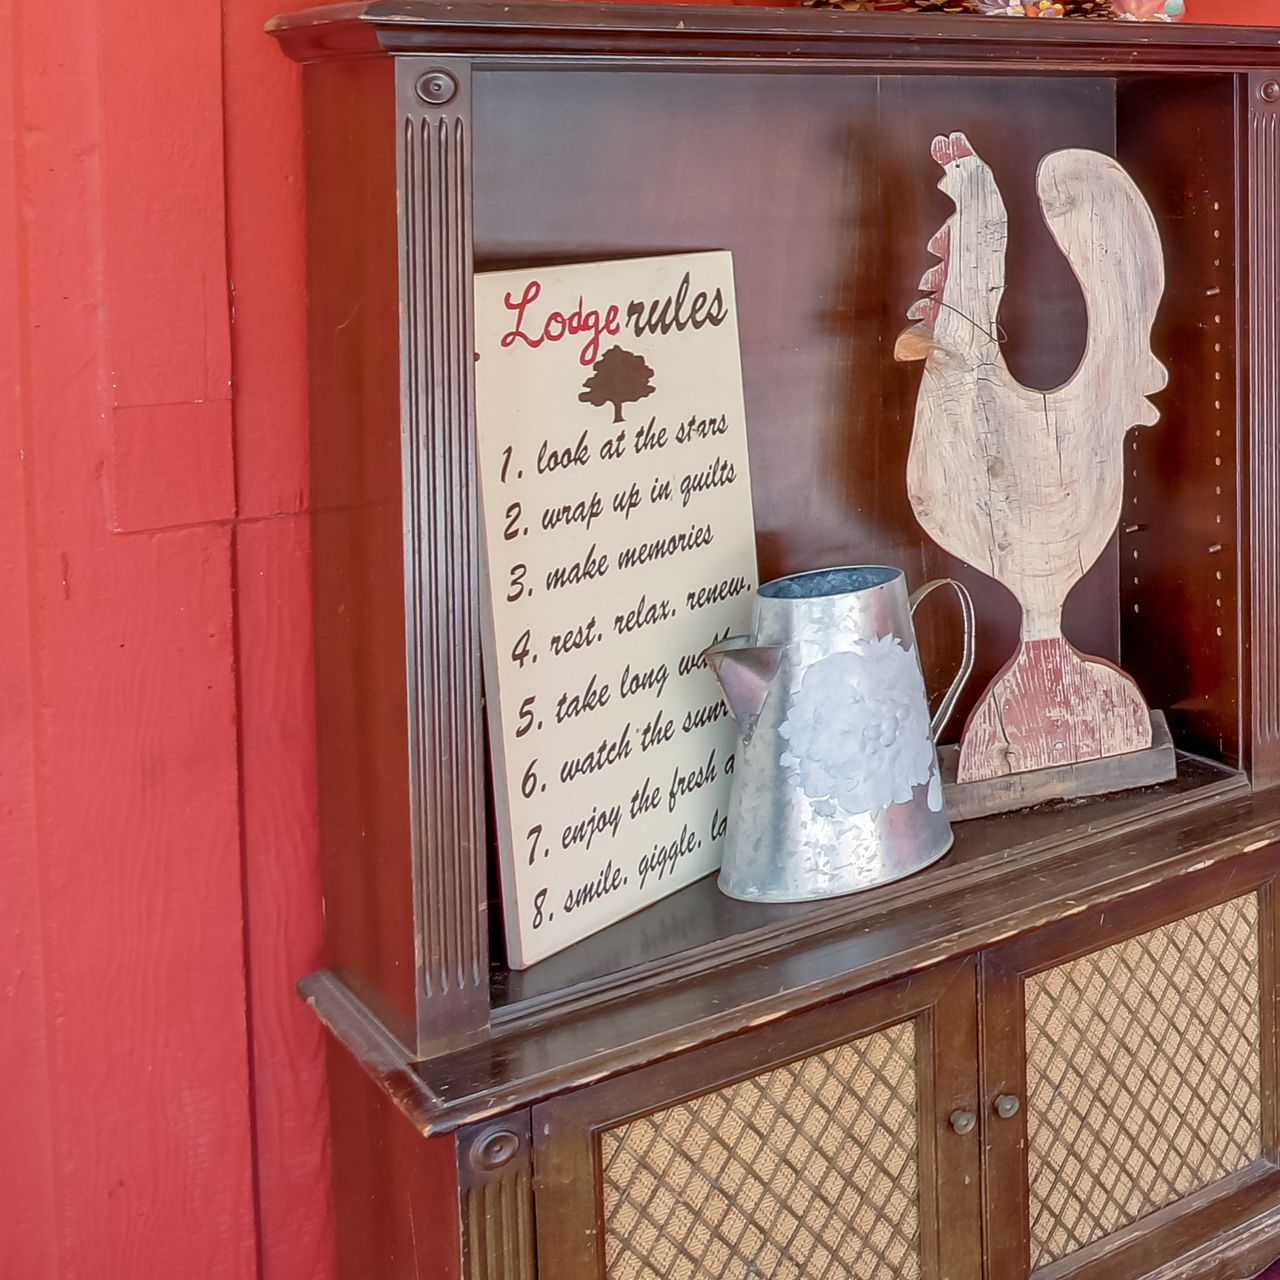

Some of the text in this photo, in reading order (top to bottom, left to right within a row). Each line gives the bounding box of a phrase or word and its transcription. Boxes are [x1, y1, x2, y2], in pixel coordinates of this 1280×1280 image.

[501, 271, 729, 366] Lodge rules
[500, 414, 729, 483] 1. look at the stars
[504, 456, 737, 541] 2. wrap up in quilts
[506, 523, 714, 602] 3. make memories
[511, 629, 538, 669] 4.
[516, 696, 543, 738] 5.
[555, 674, 611, 726] take
[620, 664, 670, 709] long
[520, 758, 547, 800] 6.
[560, 723, 633, 783] watch
[640, 710, 675, 752] the
[526, 824, 550, 866] 7.
[561, 804, 622, 850] enjoy
[630, 777, 662, 820] the
[669, 748, 717, 813] fresh
[532, 888, 554, 930] 8.
